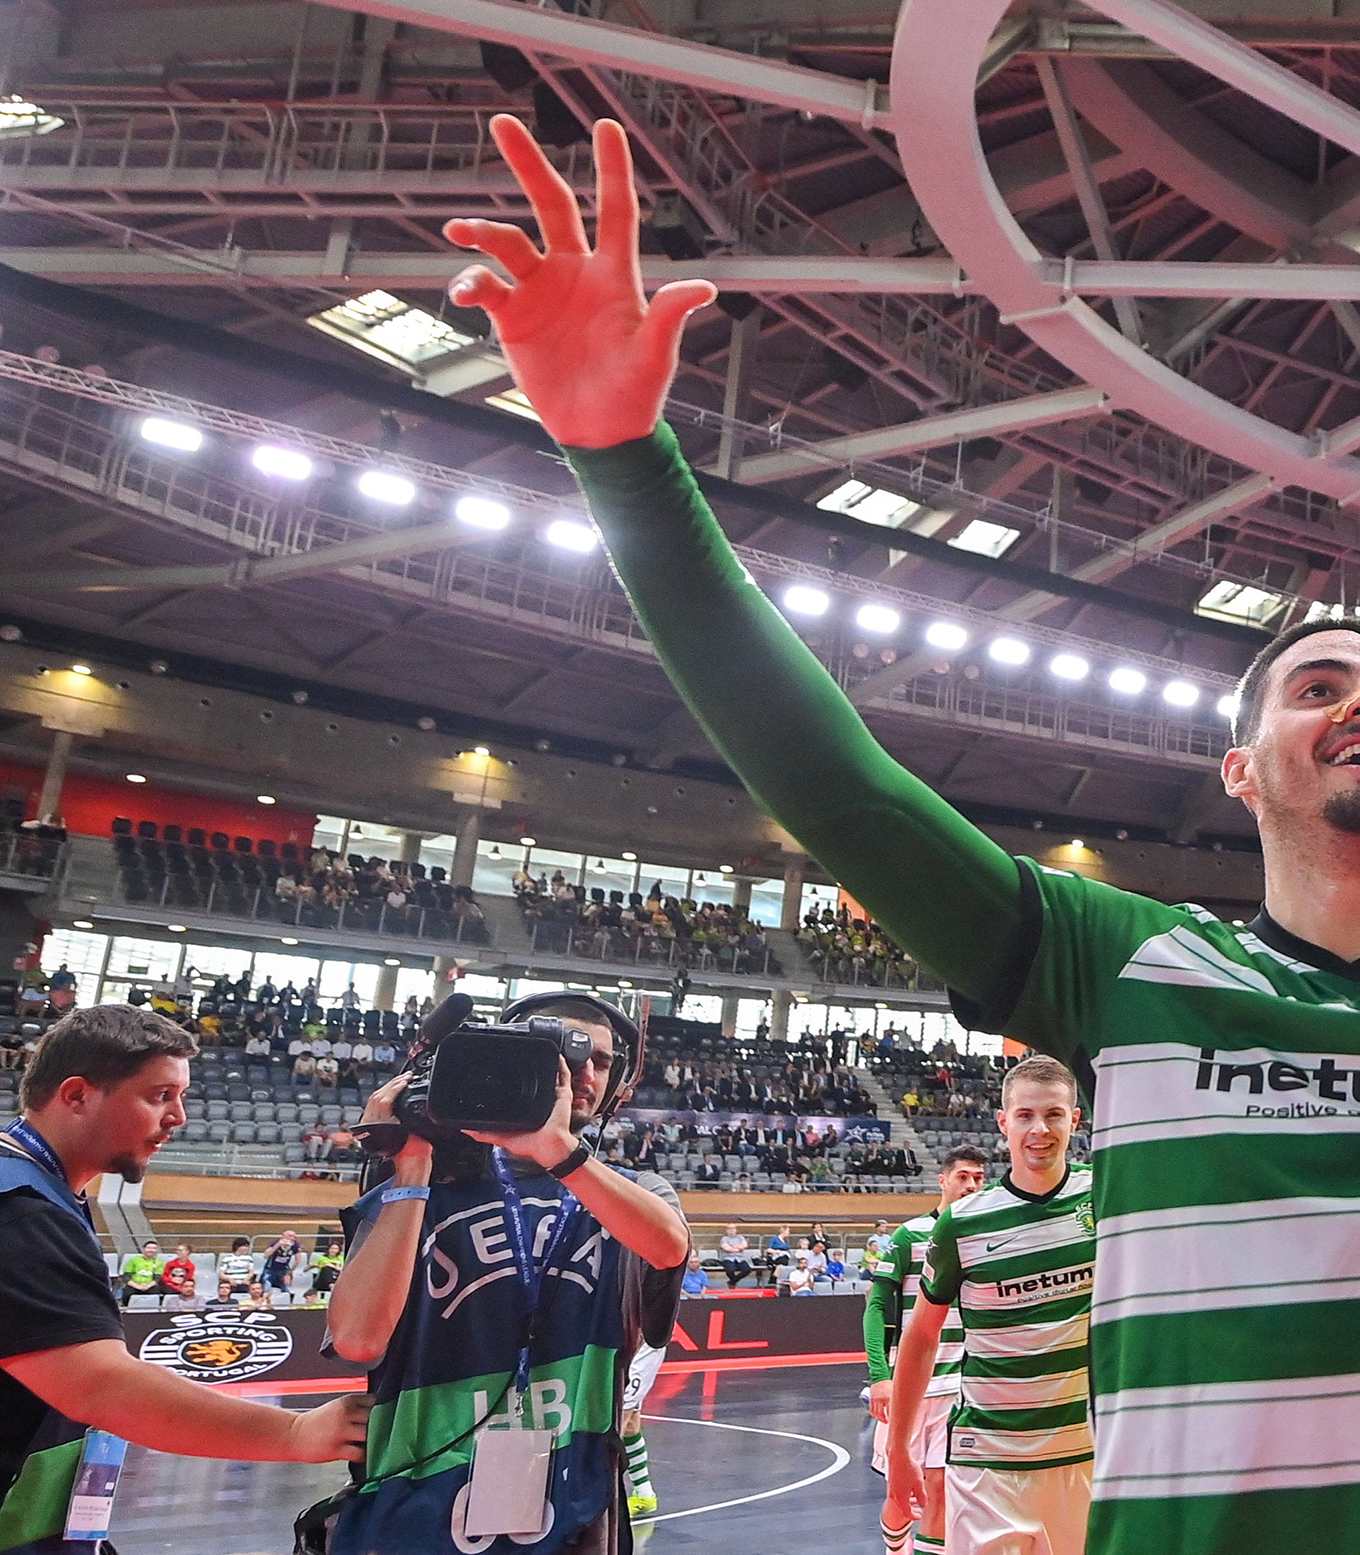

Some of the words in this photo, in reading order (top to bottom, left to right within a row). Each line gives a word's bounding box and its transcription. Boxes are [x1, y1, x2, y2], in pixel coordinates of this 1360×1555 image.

[1246, 1101, 1337, 1117] Positive
[427, 1214, 611, 1299] UEFA
[996, 1267, 1093, 1297] inetum
[170, 1311, 277, 1327] SCP
[159, 1327, 278, 1345] SPORTING
